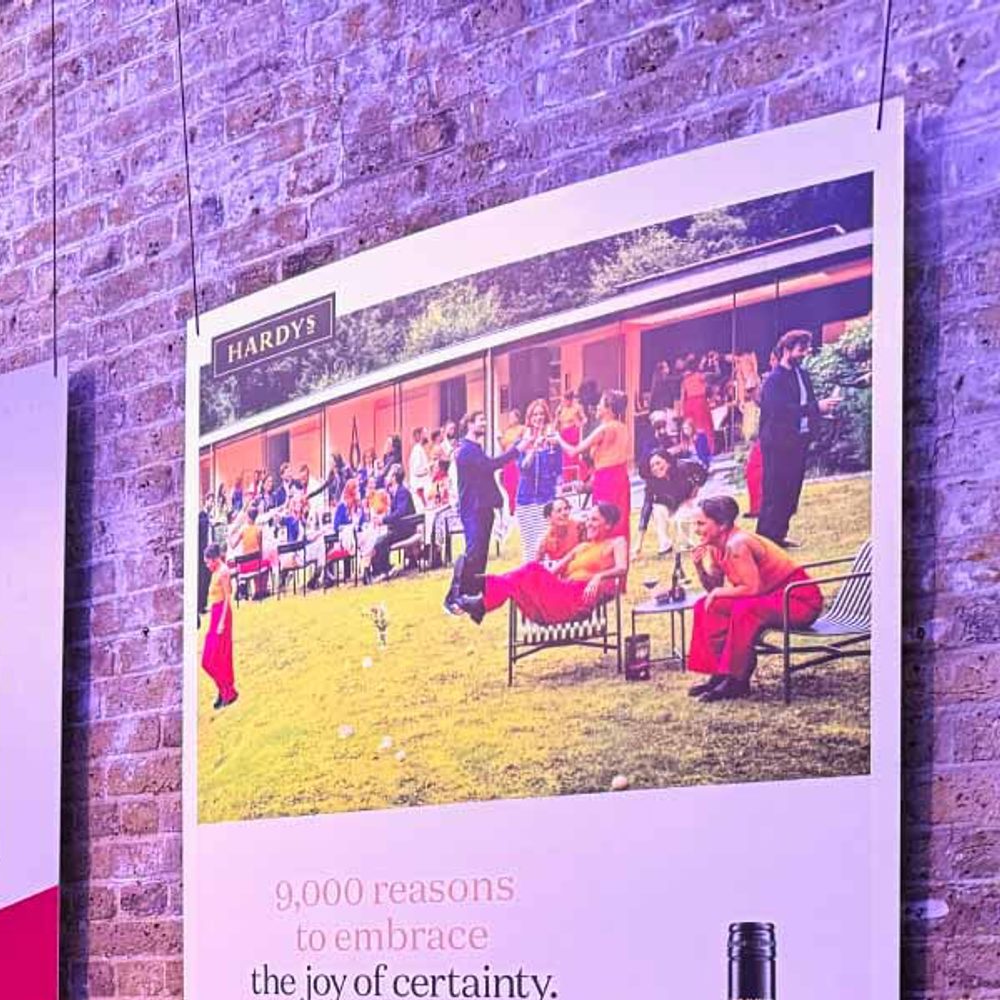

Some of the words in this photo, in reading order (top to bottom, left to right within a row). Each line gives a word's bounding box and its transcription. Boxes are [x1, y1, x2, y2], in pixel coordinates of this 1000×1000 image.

[227, 314, 317, 364] HARDYS
[275, 876, 364, 913] 9,000
[373, 873, 516, 906] reasons
[295, 923, 326, 953] to
[335, 916, 490, 952] embrace
[250, 963, 297, 996] the
[353, 963, 388, 997] of
